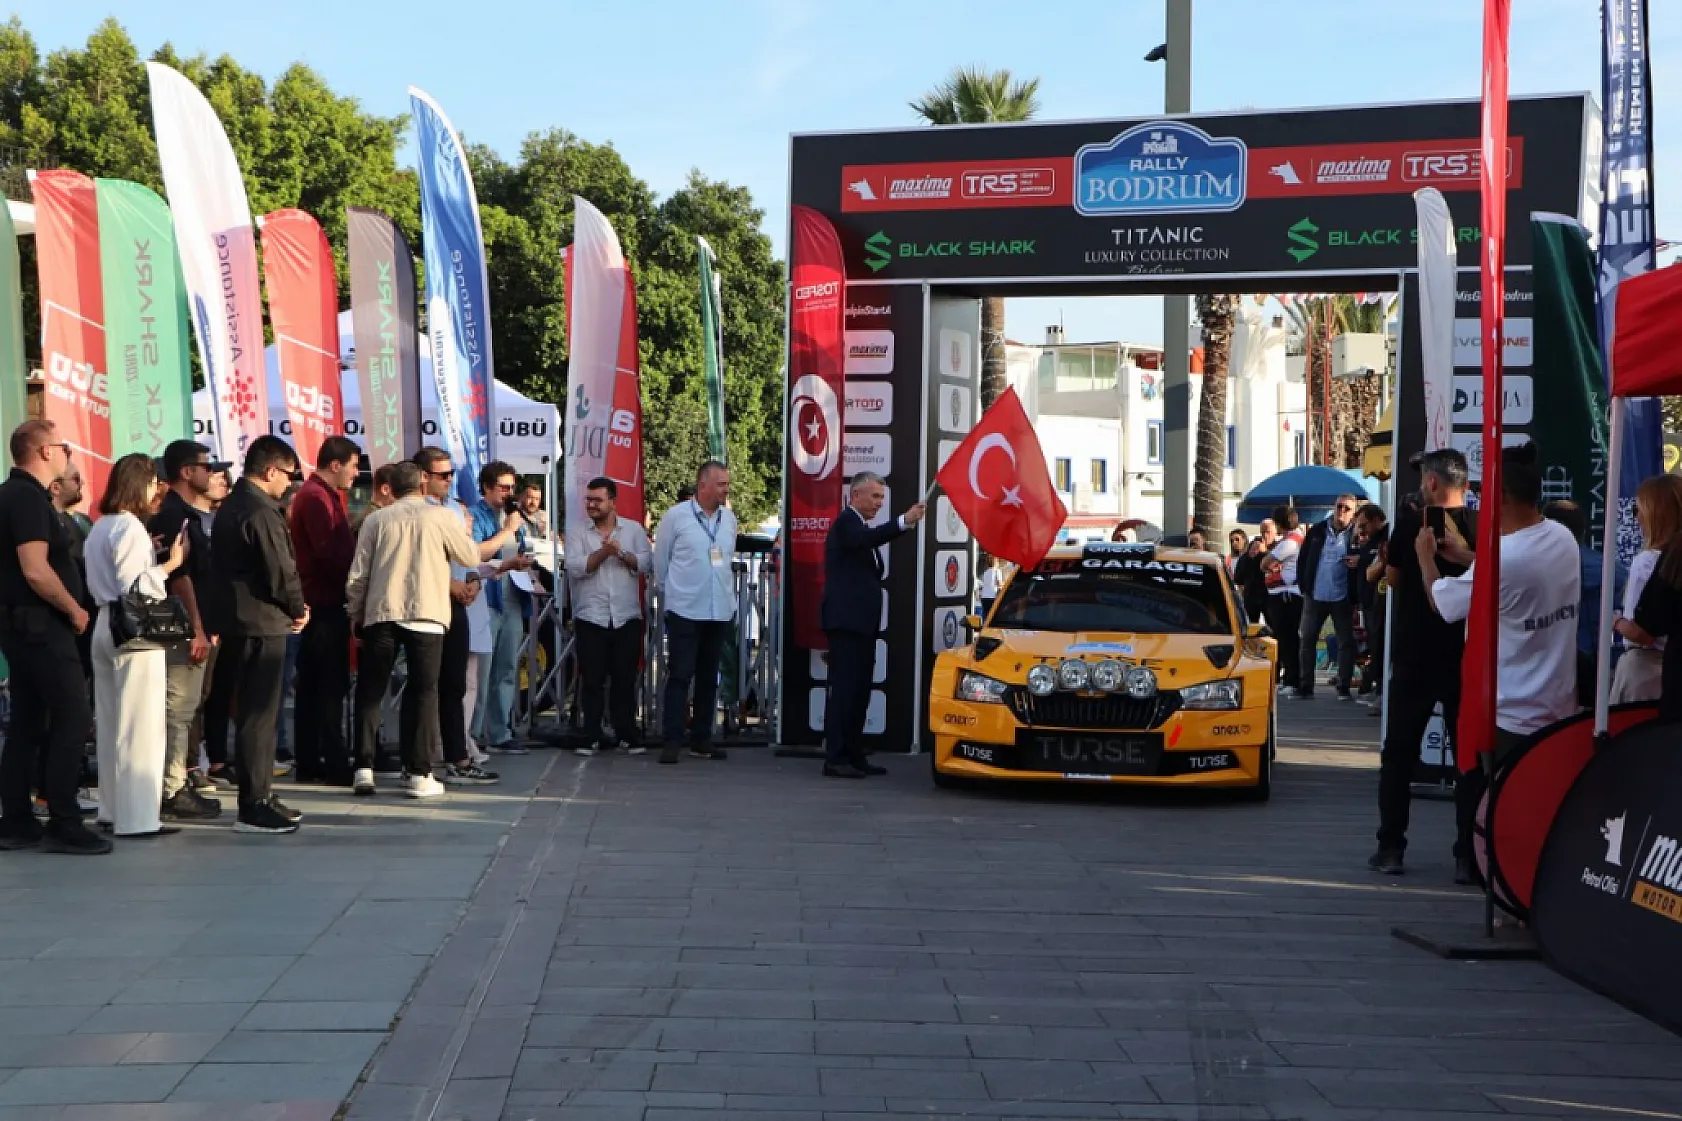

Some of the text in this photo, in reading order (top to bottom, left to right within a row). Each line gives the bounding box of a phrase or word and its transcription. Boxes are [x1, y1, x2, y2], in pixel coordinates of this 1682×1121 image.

[1130, 156, 1189, 171] RALLY
[1318, 156, 1392, 176] maxima
[1406, 154, 1469, 177] TRS
[889, 174, 953, 192] maxima
[965, 172, 1019, 194] TRS
[1087, 170, 1234, 202] BODRUM
[1111, 226, 1204, 245] TITANIC
[1329, 229, 1401, 246] BLACK
[899, 240, 1036, 257] BLACK SHARK
[1085, 248, 1230, 263] LUXURY COLLECTION
[1082, 559, 1203, 575] GARAGE
[1037, 737, 1146, 763] TURSE
